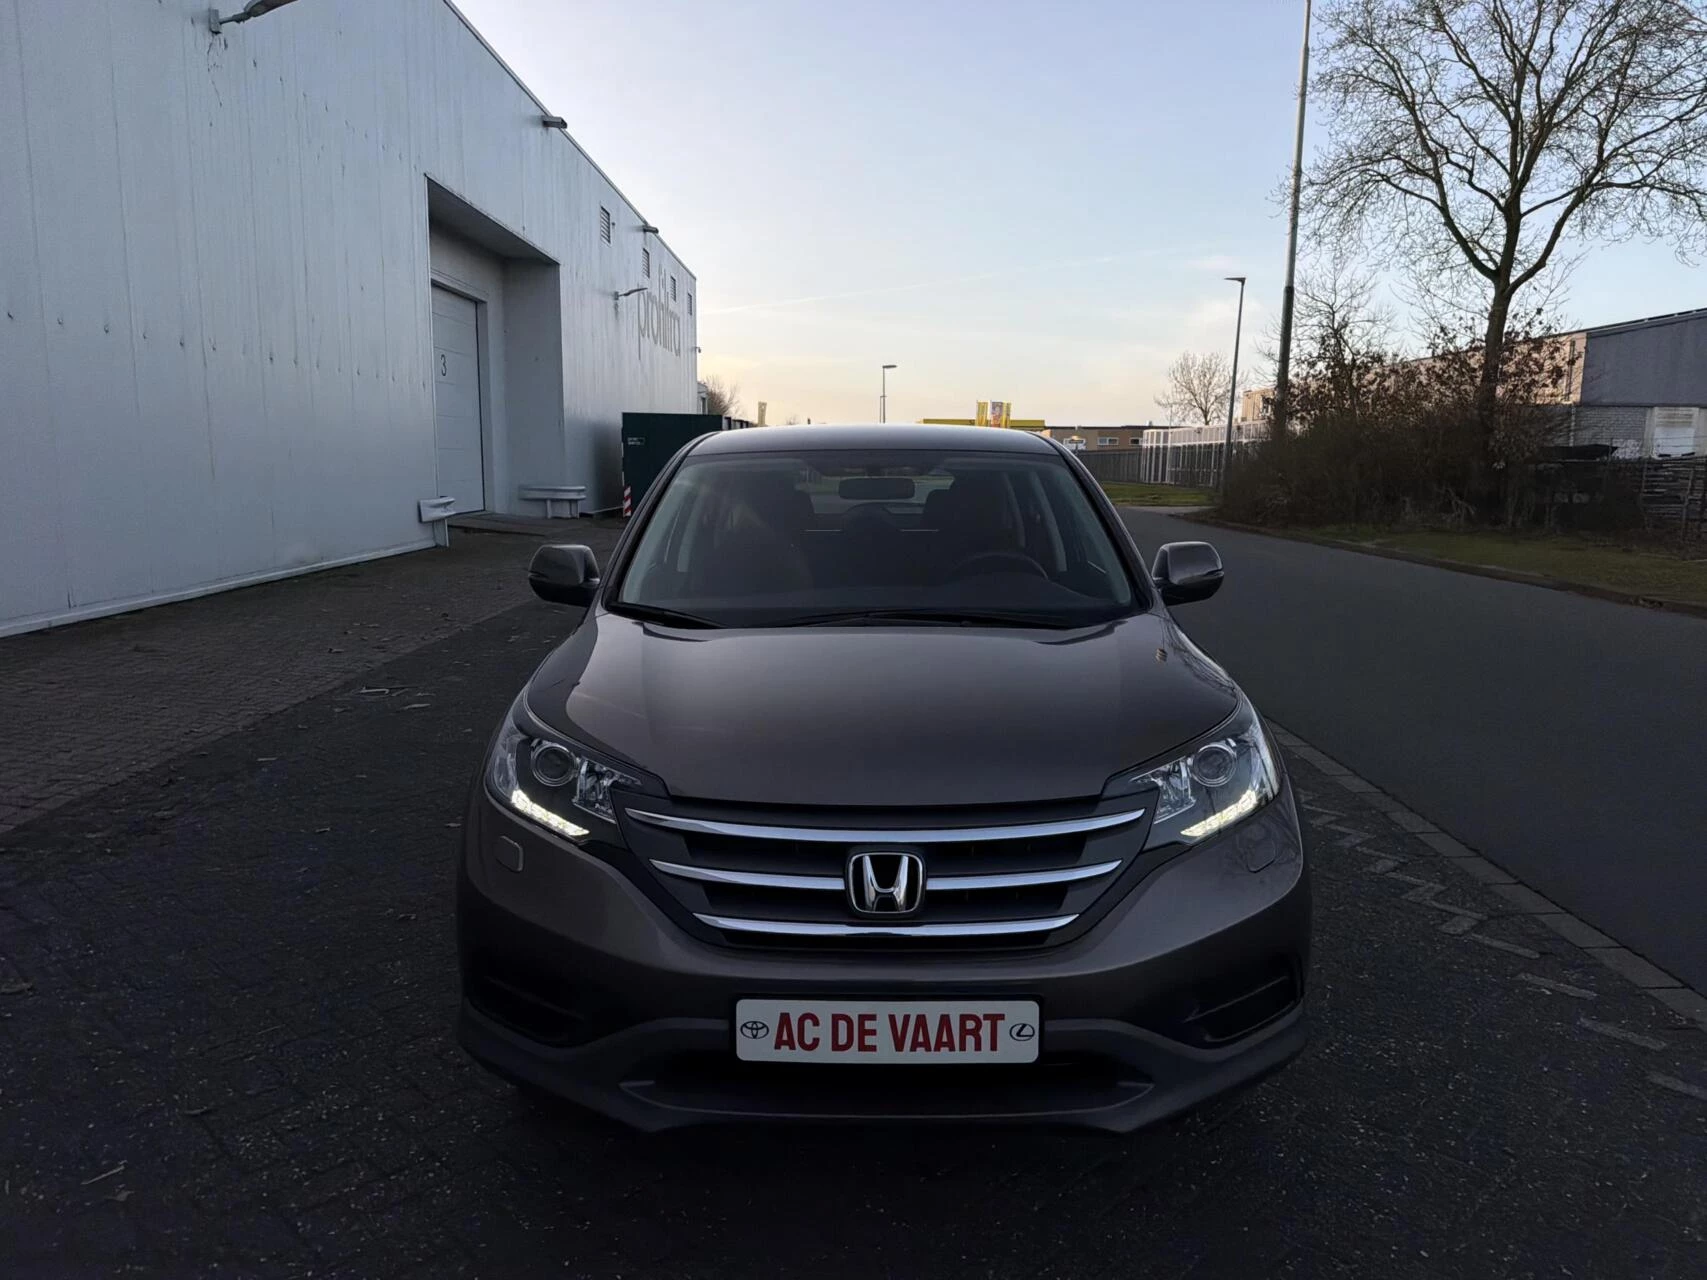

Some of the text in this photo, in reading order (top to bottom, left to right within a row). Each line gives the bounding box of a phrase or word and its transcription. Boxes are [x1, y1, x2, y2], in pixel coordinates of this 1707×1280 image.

[441, 354, 447, 376] 3
[774, 1012, 1005, 1052] AC DE VAART
